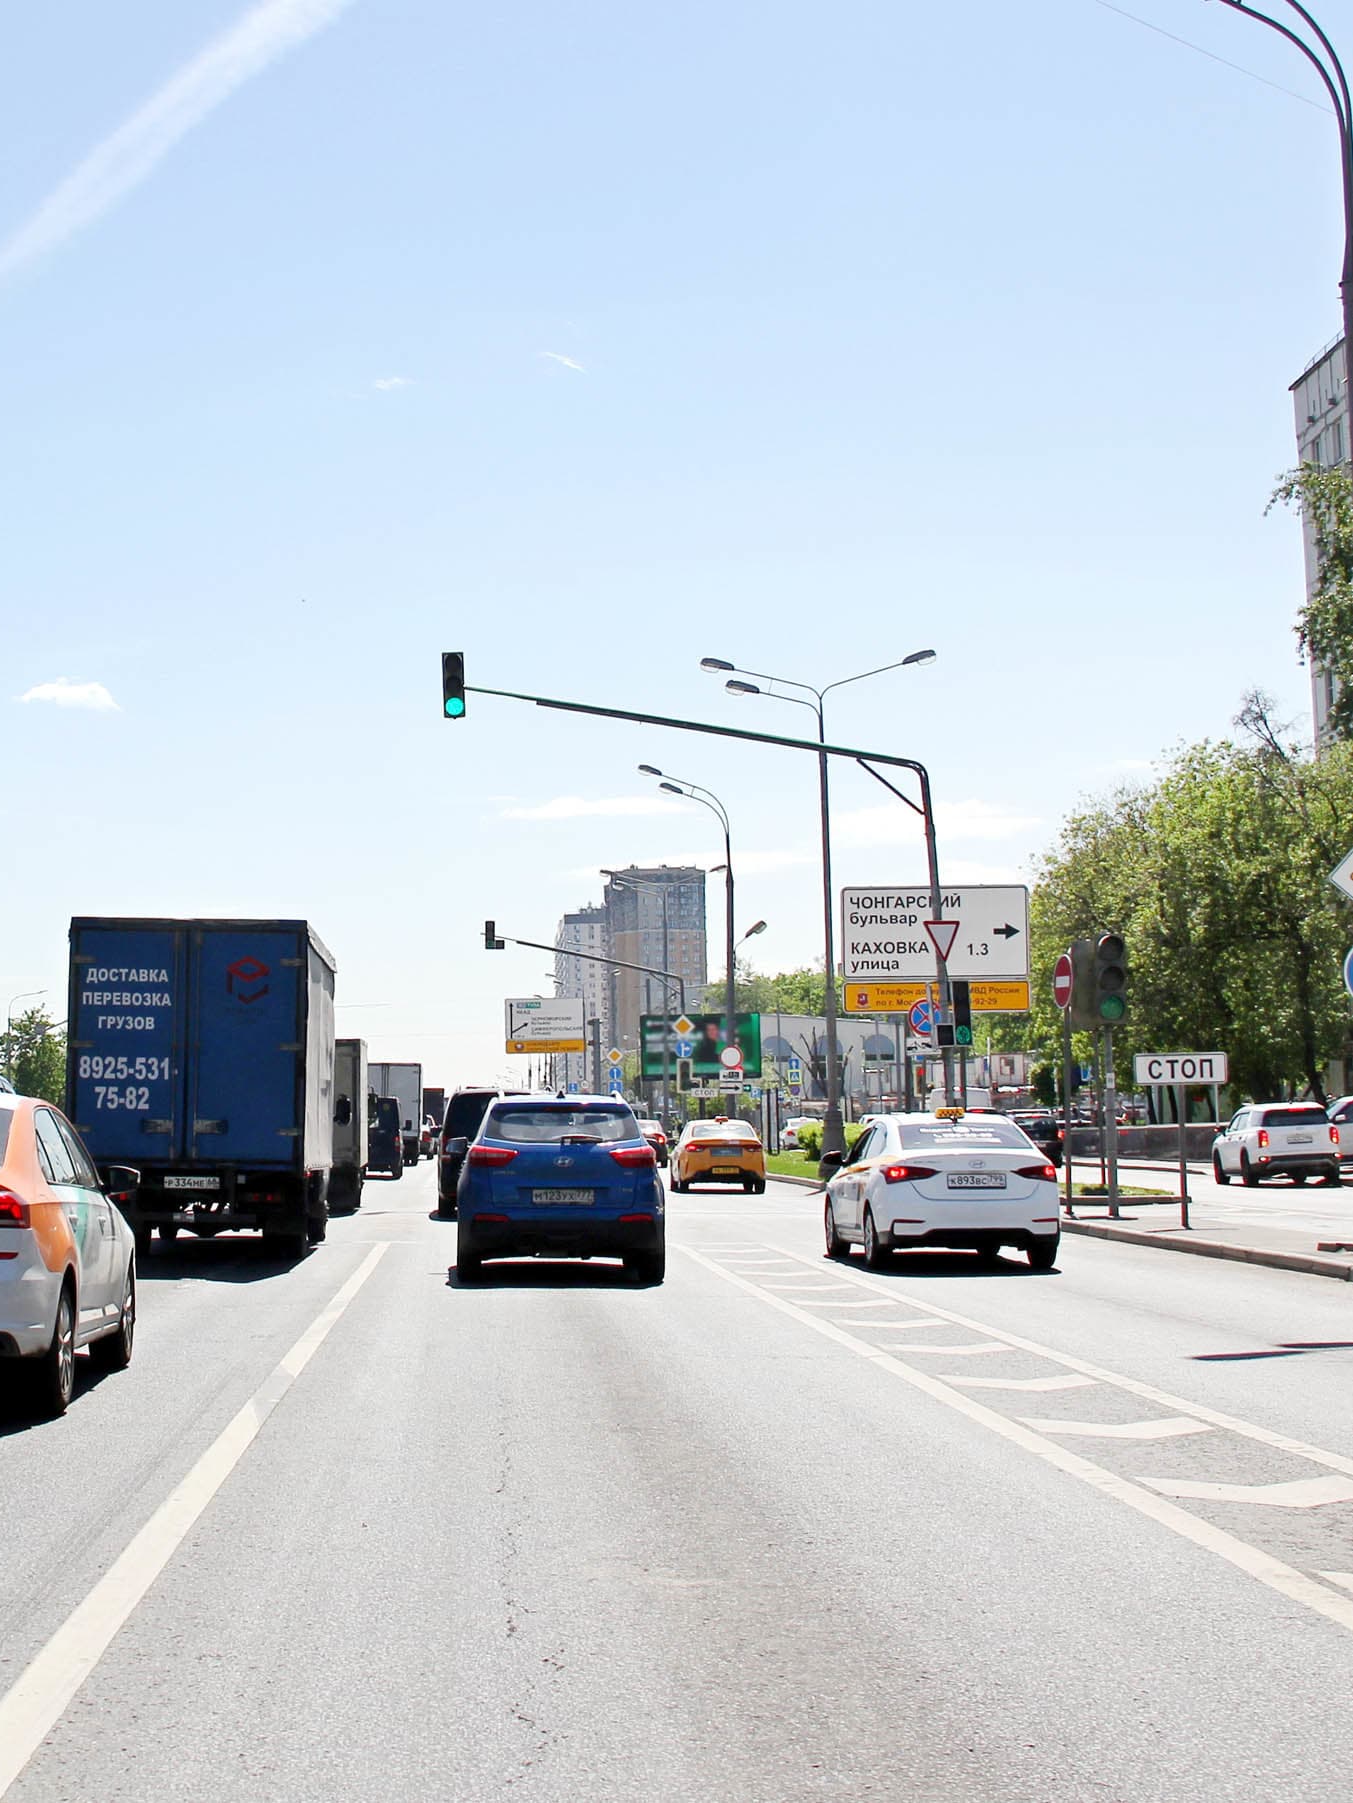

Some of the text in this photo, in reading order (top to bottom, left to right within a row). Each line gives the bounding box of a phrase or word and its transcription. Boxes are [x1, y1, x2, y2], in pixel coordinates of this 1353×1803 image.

[850, 892, 961, 909] ЧОНГАРСИЙ
[850, 912, 918, 927] бульвар
[851, 941, 989, 956] КАХОВКА 1.3
[851, 960, 899, 973] улица
[86, 968, 169, 983] ДОСТАВКА
[876, 988, 913, 997] Телефон
[990, 986, 1020, 994] России
[82, 992, 172, 1007] ПЕРЕВОЗКА
[98, 1016, 155, 1030] ГРУЗОВ
[1148, 1059, 1214, 1079] СТОП
[94, 1087, 150, 1110] 75-82
[950, 1175, 988, 1185] К893ВС
